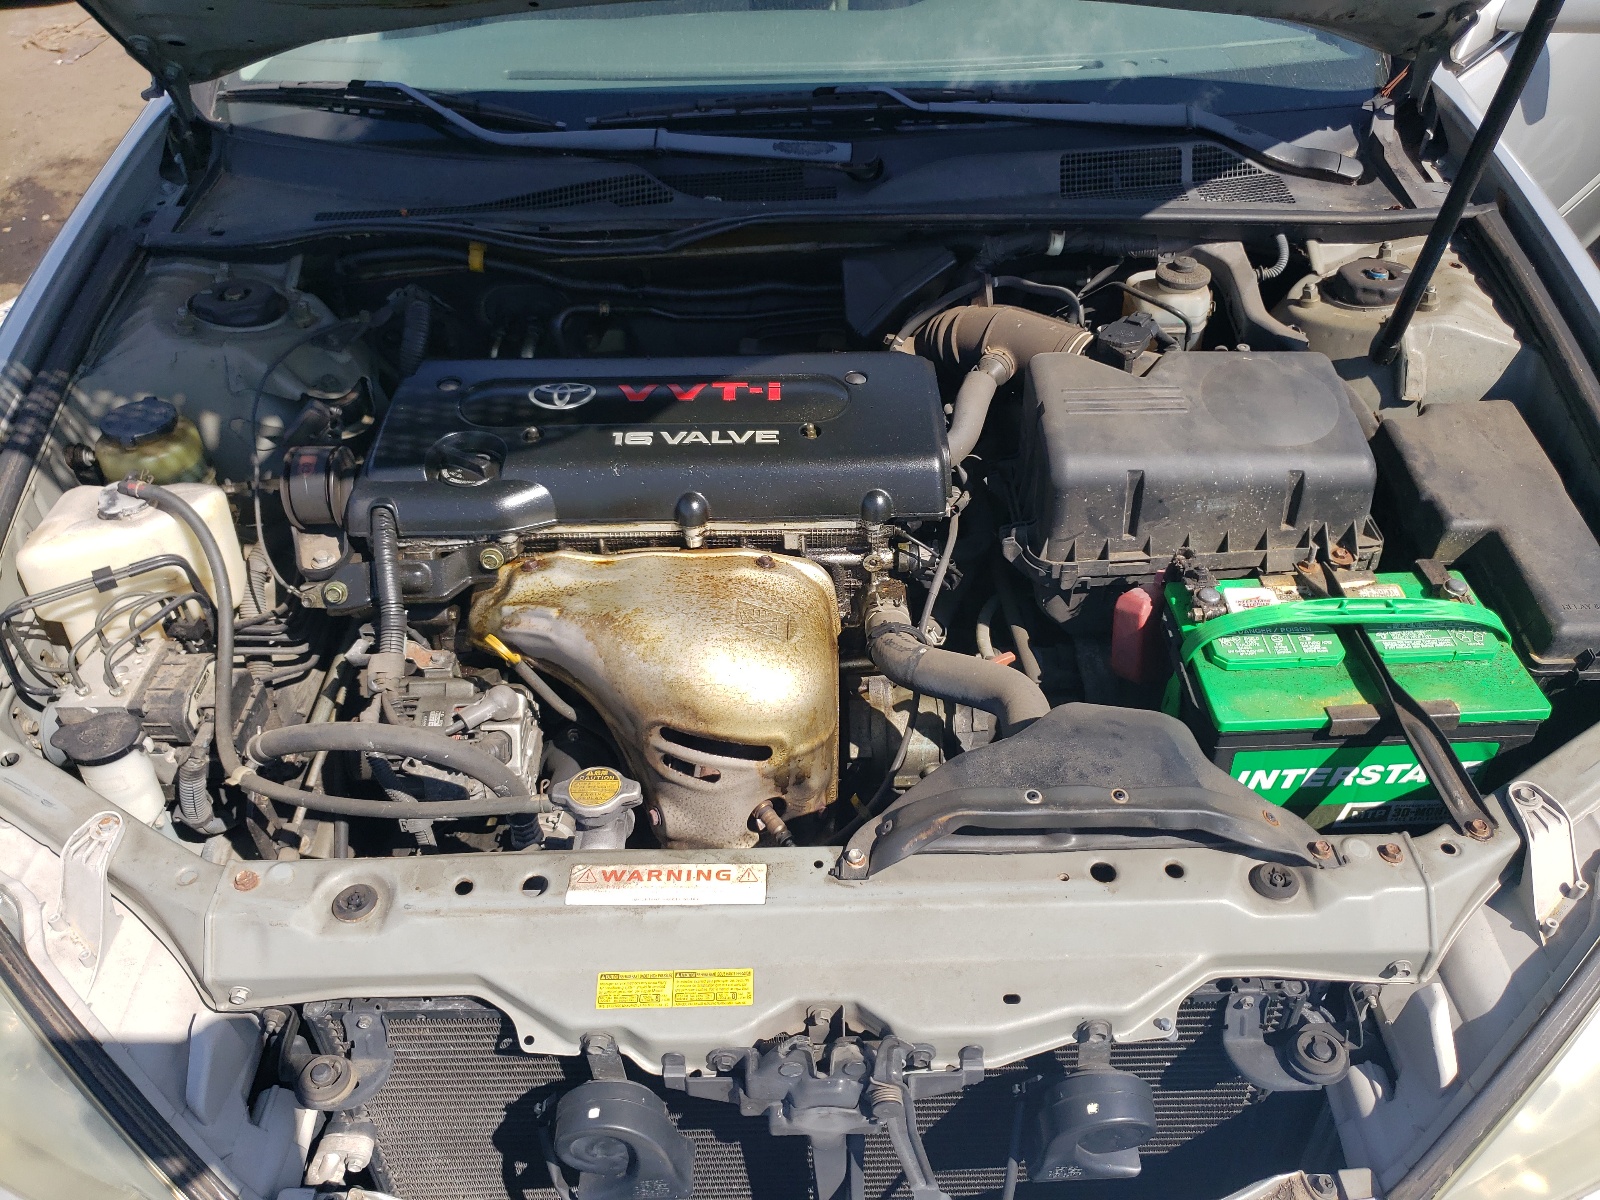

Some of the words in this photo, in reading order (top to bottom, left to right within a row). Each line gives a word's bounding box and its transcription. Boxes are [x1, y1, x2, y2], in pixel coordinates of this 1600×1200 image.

[618, 381, 782, 402] VVT-i
[612, 431, 654, 446] 16
[660, 430, 780, 446] VALVE
[1237, 761, 1484, 790] INTERSTA
[601, 869, 732, 882] WARNING
